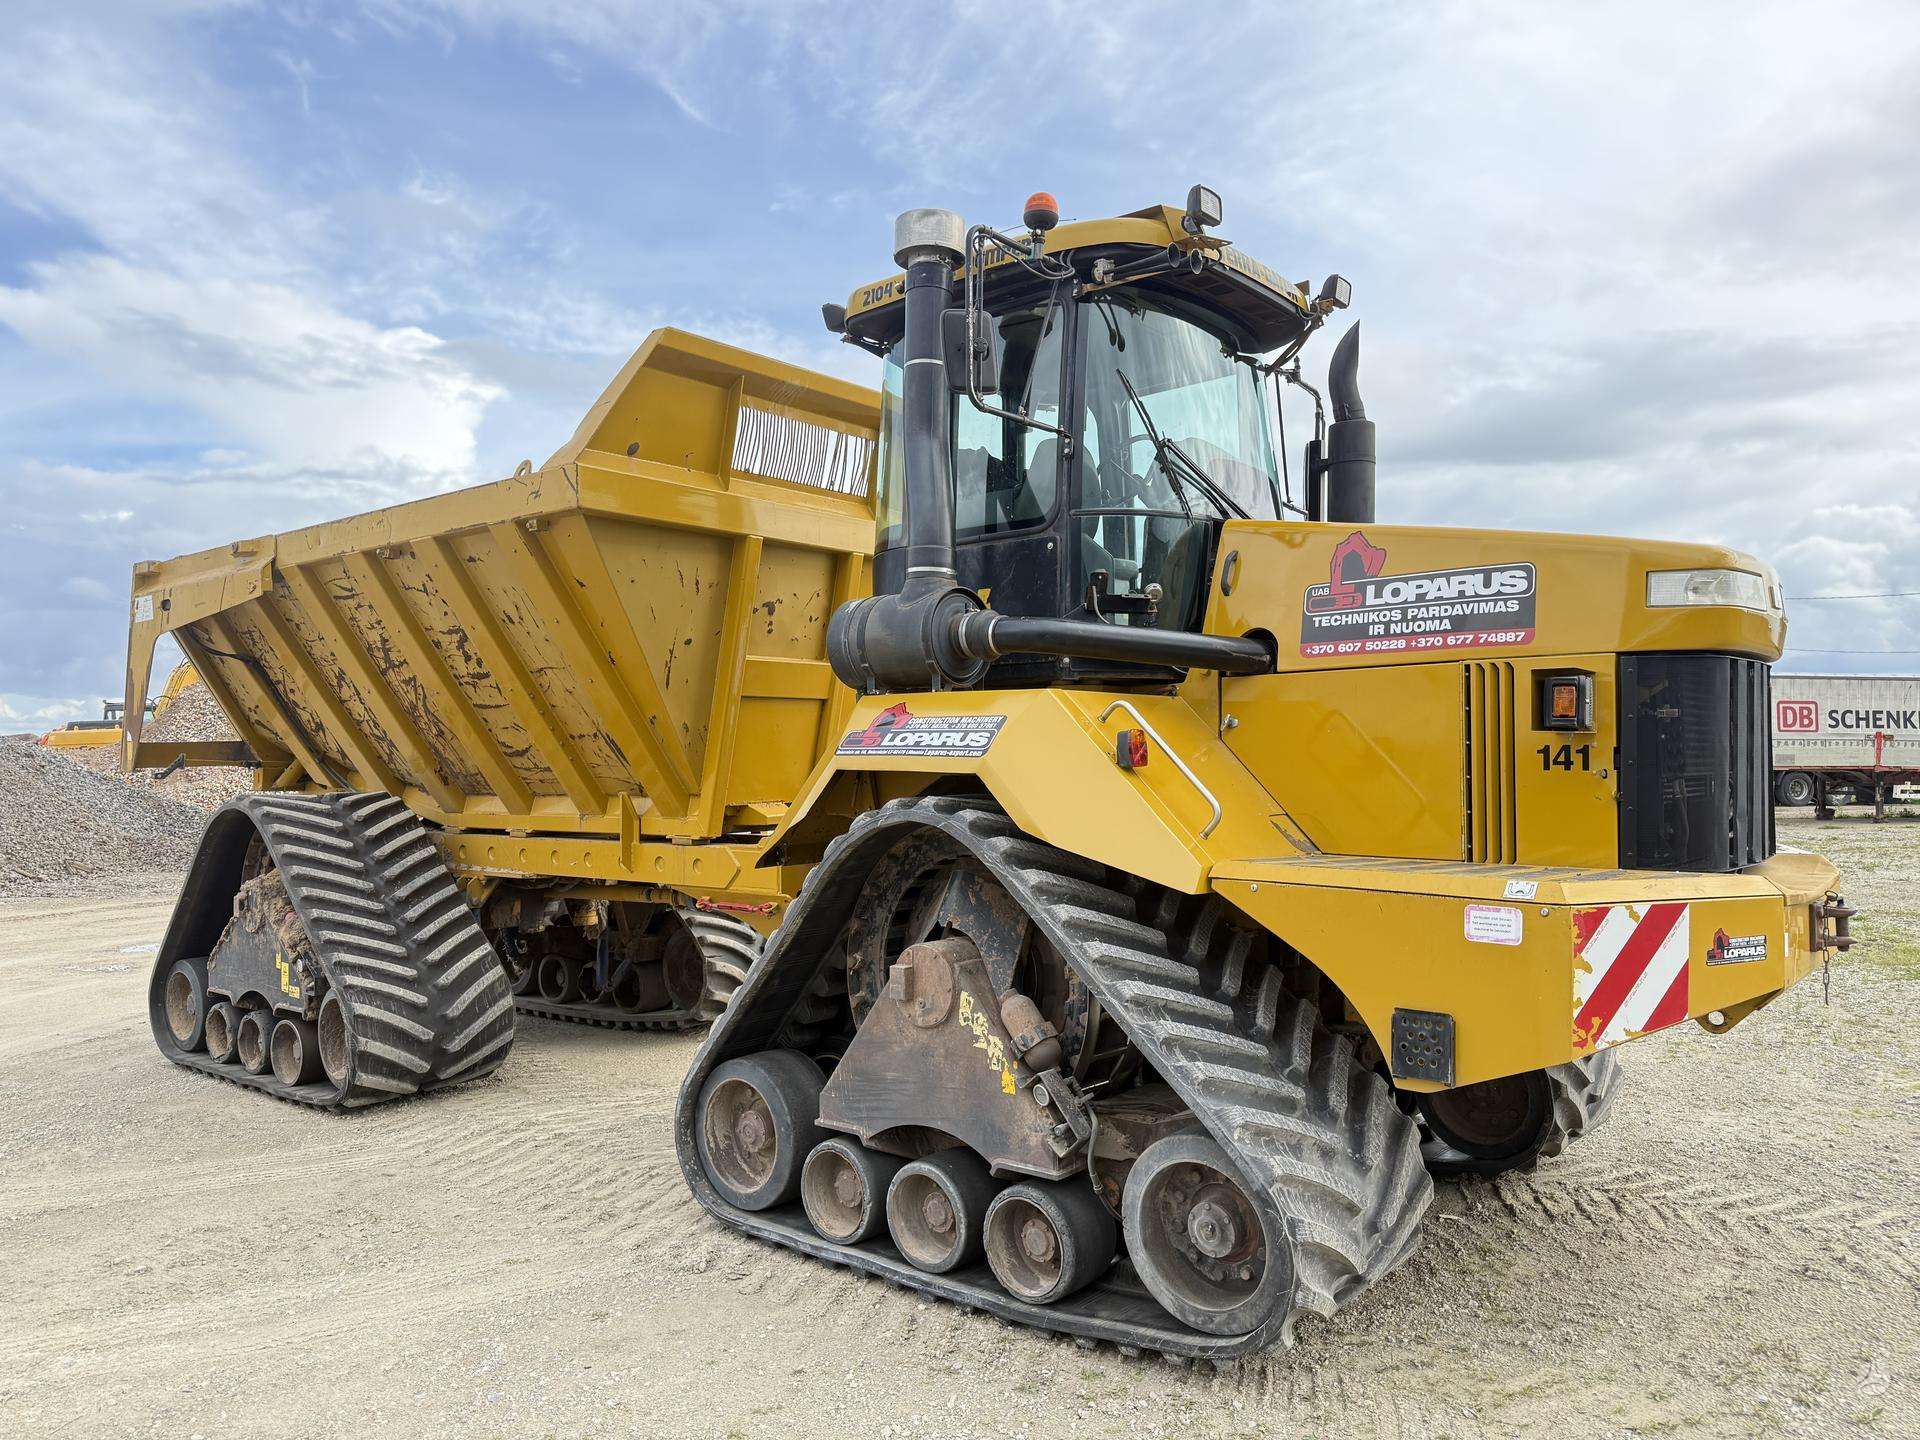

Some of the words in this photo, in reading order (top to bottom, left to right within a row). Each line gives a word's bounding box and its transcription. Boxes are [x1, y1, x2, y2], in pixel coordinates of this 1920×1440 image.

[862, 282, 893, 307] 2104
[1312, 587, 1330, 597] UAB
[1366, 570, 1528, 606] LOPARUS
[1312, 609, 1402, 628] TECHNIKOS
[1407, 599, 1520, 620] PARDAVIMAS
[1368, 625, 1385, 636] IR
[1390, 619, 1452, 635] NUOMA
[1305, 644, 1335, 655] +370
[1338, 642, 1361, 653] 607
[1365, 639, 1406, 651] 50228
[1410, 636, 1443, 648] +370
[1447, 634, 1474, 645] 677
[1478, 631, 1526, 643] 74887
[909, 716, 959, 725] CONSTRUCTION
[959, 716, 1004, 724] MACHINERY
[1782, 706, 1814, 729] DB
[1828, 709, 1920, 730] SCHENK
[880, 732, 991, 747] LOPARUS
[1536, 744, 1590, 771] 141
[1724, 946, 1765, 958] LOPARUS
